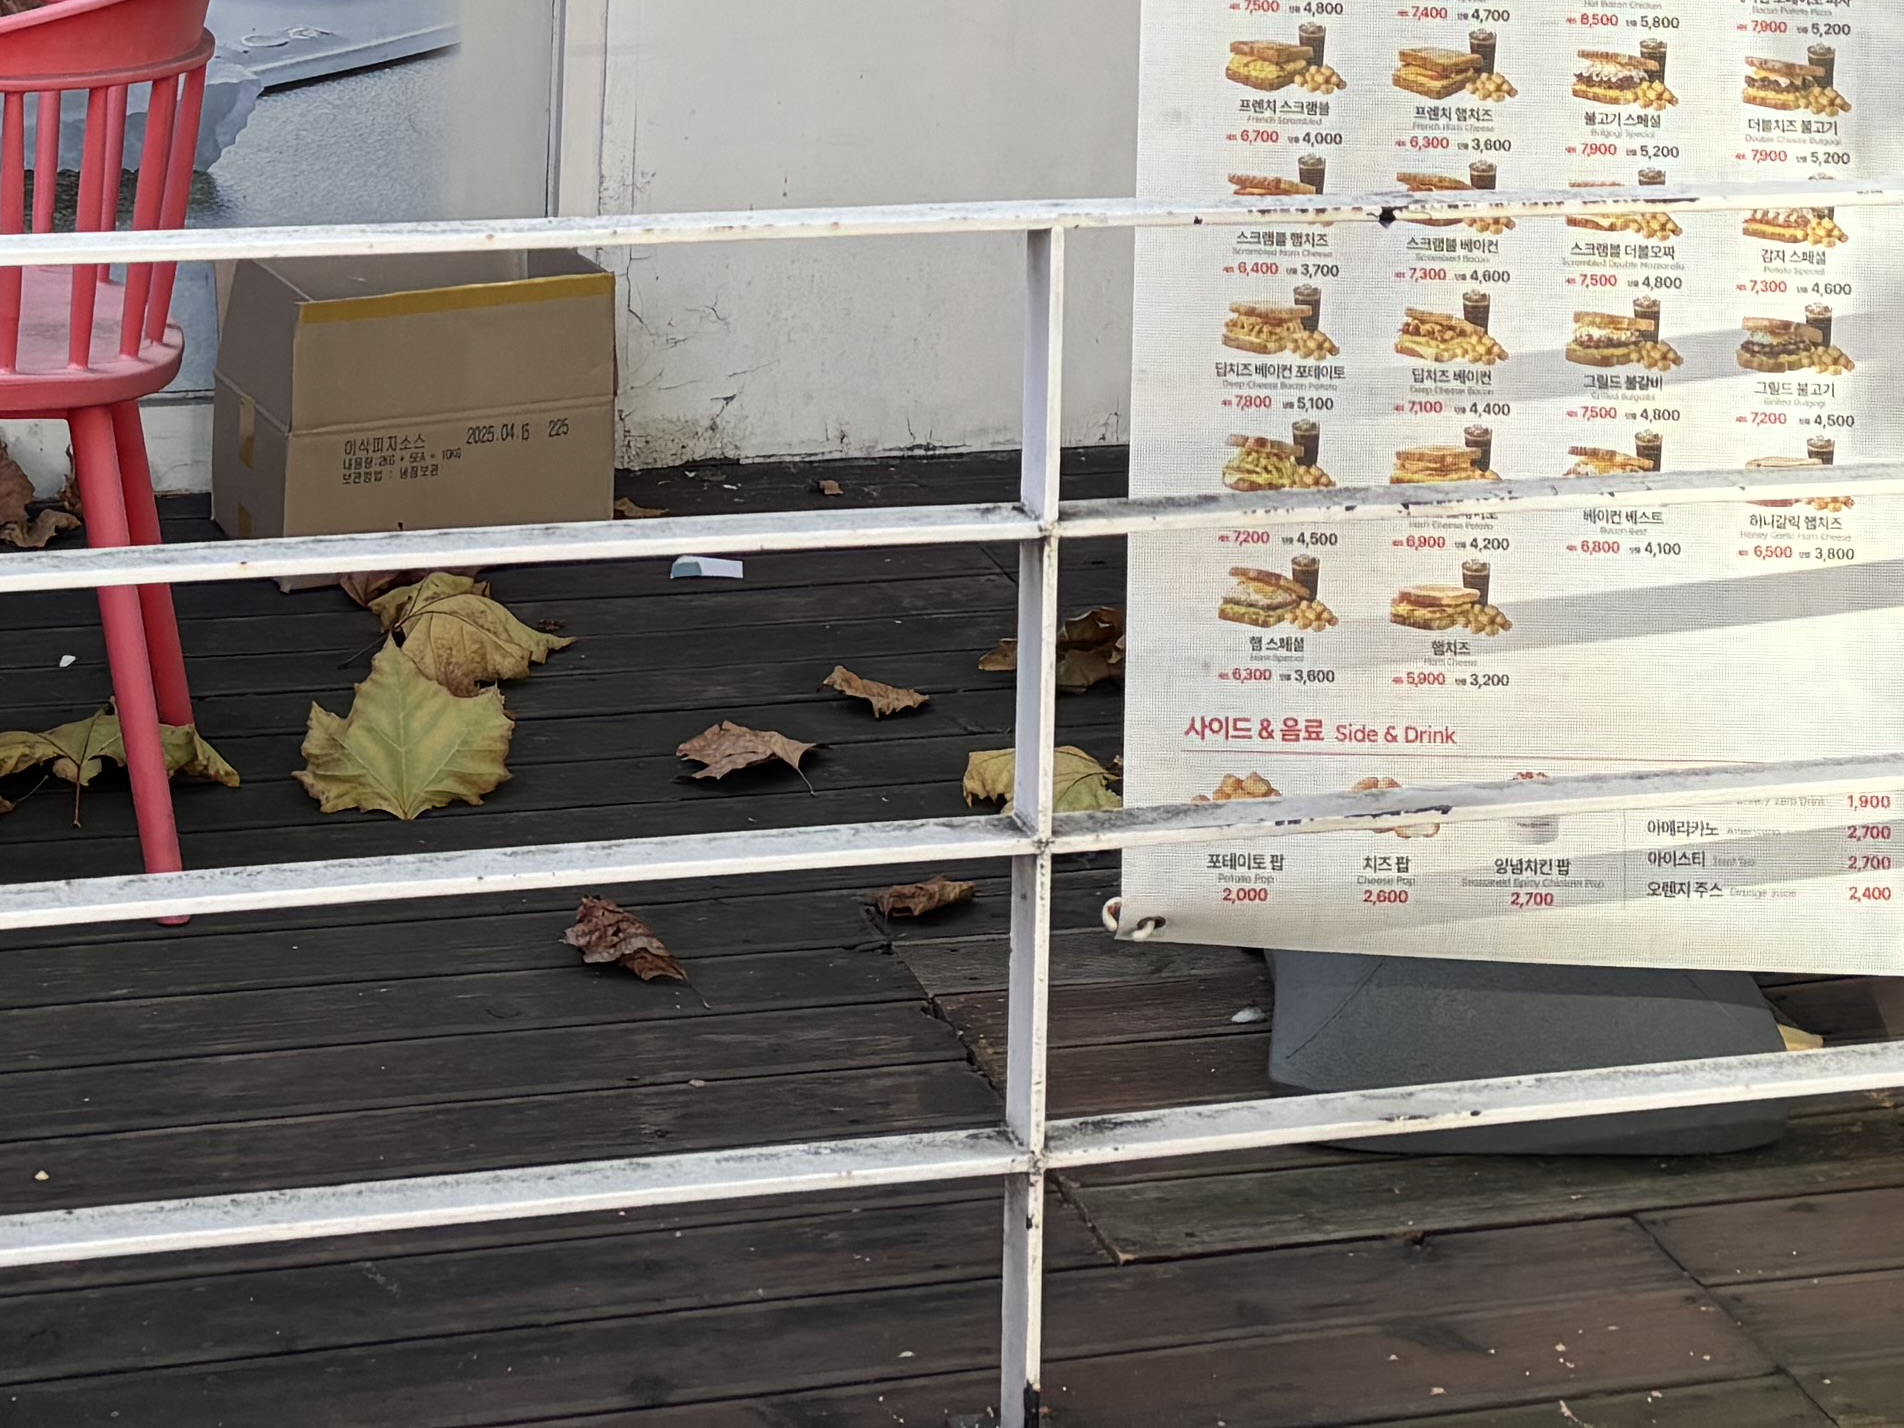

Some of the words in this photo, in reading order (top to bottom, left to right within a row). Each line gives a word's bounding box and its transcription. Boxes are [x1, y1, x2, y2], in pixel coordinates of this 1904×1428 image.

[1244, 0, 1280, 13] 7,500
[1303, 1, 1344, 17] 4,800
[1411, 6, 1448, 21] 7,400
[1471, 8, 1510, 24] 4,700
[1580, 13, 1619, 27] 8,500
[1640, 15, 1680, 29] 5,800
[1751, 20, 1787, 34] 7,900
[1811, 22, 1851, 37] 5,200
[1239, 99, 1277, 114] 프렌치
[1414, 106, 1451, 122] 프렌치
[1240, 130, 1279, 144] 6,700
[1302, 132, 1343, 147] 4,000
[1410, 136, 1449, 150] 6,300
[1471, 138, 1512, 153] 3,600
[1582, 143, 1618, 157] 7,900
[1640, 145, 1680, 159] 5,200
[1751, 149, 1788, 164] 7,900
[1810, 151, 1850, 166] 5,200
[1238, 261, 1279, 276] 6,400
[1300, 264, 1340, 278] 3,700
[1409, 268, 1447, 282] 7,300
[1470, 270, 1510, 284] 4,600
[1580, 274, 1618, 289] 7,500
[1642, 276, 1682, 291] 4,800
[1750, 280, 1787, 295] 7,300
[1812, 282, 1852, 297] 4,600
[1254, 363, 1293, 379] 베이컨
[1235, 394, 1272, 410] 7,800
[1297, 397, 1334, 411] 5,100
[1408, 400, 1443, 414] 7,100
[1470, 402, 1510, 416] 4,400
[1581, 406, 1618, 420] 7,500
[1640, 408, 1680, 422] 4,800
[1750, 412, 1787, 426] 7,200
[1814, 414, 1855, 428] 4,500
[1233, 531, 1270, 546] 7,200
[1296, 533, 1338, 548] 4,500
[1406, 536, 1446, 550] 6,900
[1470, 538, 1510, 552] 4,200
[1581, 540, 1620, 554] 6,800
[1644, 542, 1681, 556] 4,100
[1754, 546, 1793, 560] 6,500
[1815, 548, 1854, 562] 3,800
[1232, 669, 1272, 683] 6,300
[1294, 670, 1335, 684] 3,600
[1406, 672, 1446, 687] 5,900
[1470, 674, 1510, 688] 3,200
[1184, 716, 1253, 742] 사이드
[1258, 722, 1275, 741] &
[1280, 718, 1324, 743] 음료
[1335, 724, 1379, 742] Side
[1385, 726, 1398, 744] &
[1404, 726, 1456, 745] Drink
[1847, 795, 1891, 811] 1,900
[1847, 825, 1891, 840] 2,700
[1207, 853, 1269, 871] 포테이토
[1271, 854, 1284, 871] 팝
[1363, 856, 1392, 873] 치즈
[1396, 856, 1411, 873] 팝
[1557, 858, 1571, 876] 팝
[1847, 856, 1891, 871] 2,700
[1222, 888, 1268, 905] 2,000
[1363, 890, 1409, 907] 2,600
[1695, 882, 1722, 898] 주스
[1848, 886, 1891, 901] 2,400
[1510, 892, 1554, 908] 2,700
